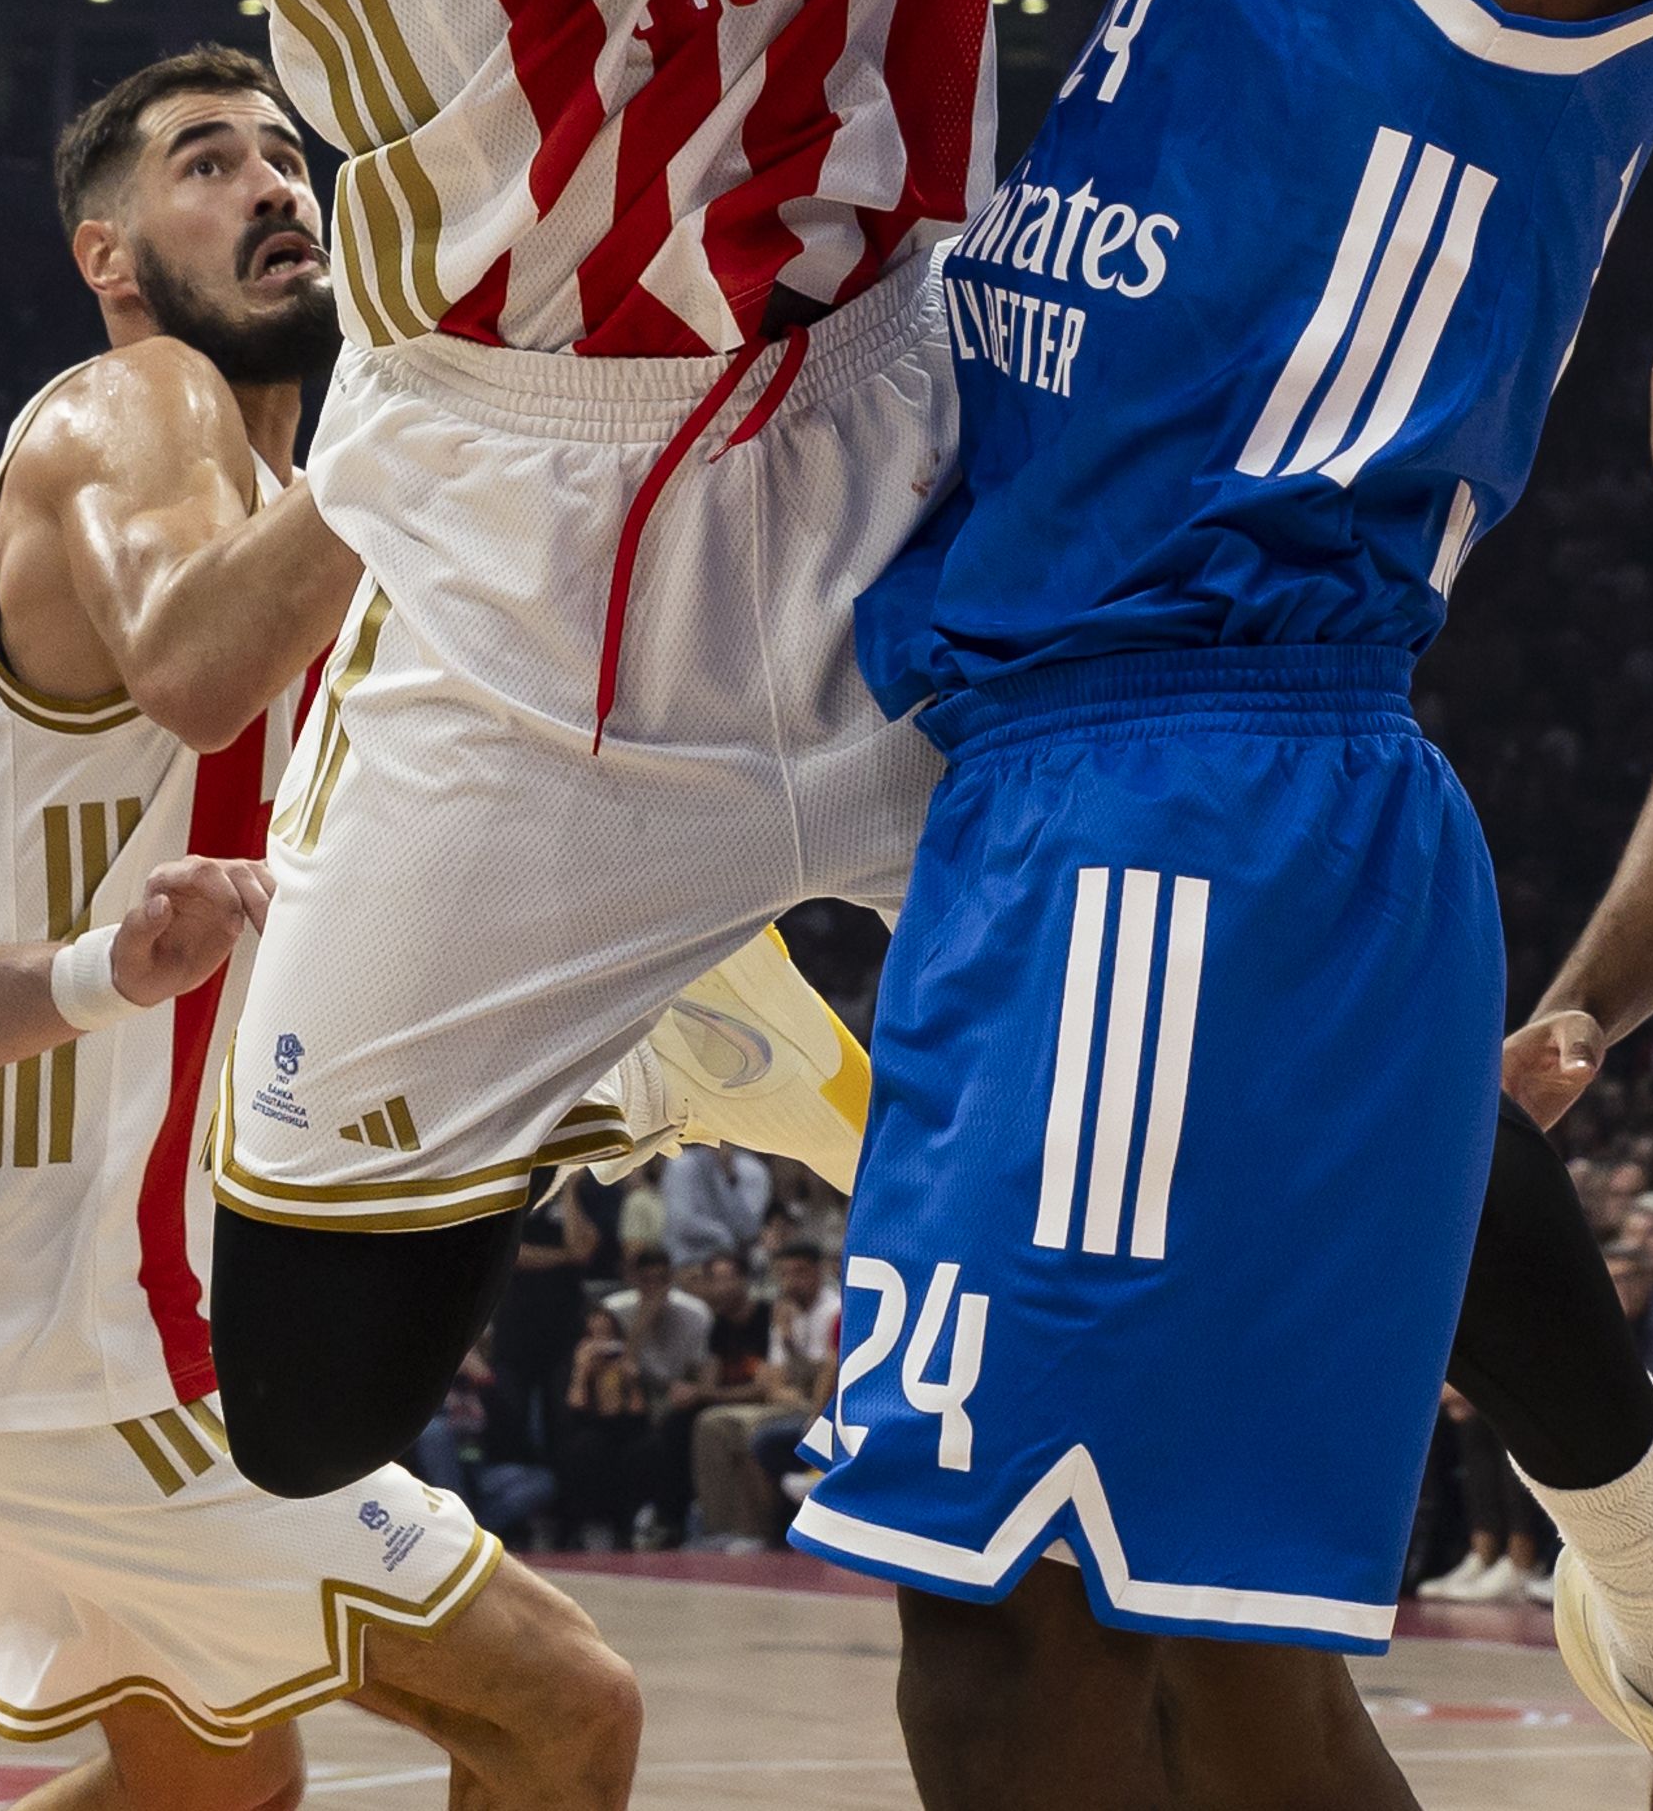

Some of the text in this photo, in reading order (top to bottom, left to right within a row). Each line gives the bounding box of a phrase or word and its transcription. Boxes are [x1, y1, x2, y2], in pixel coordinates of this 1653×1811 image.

[952, 160, 1180, 299] mirates
[945, 277, 1086, 399] LY BETTER
[834, 1256, 989, 1472] 24
